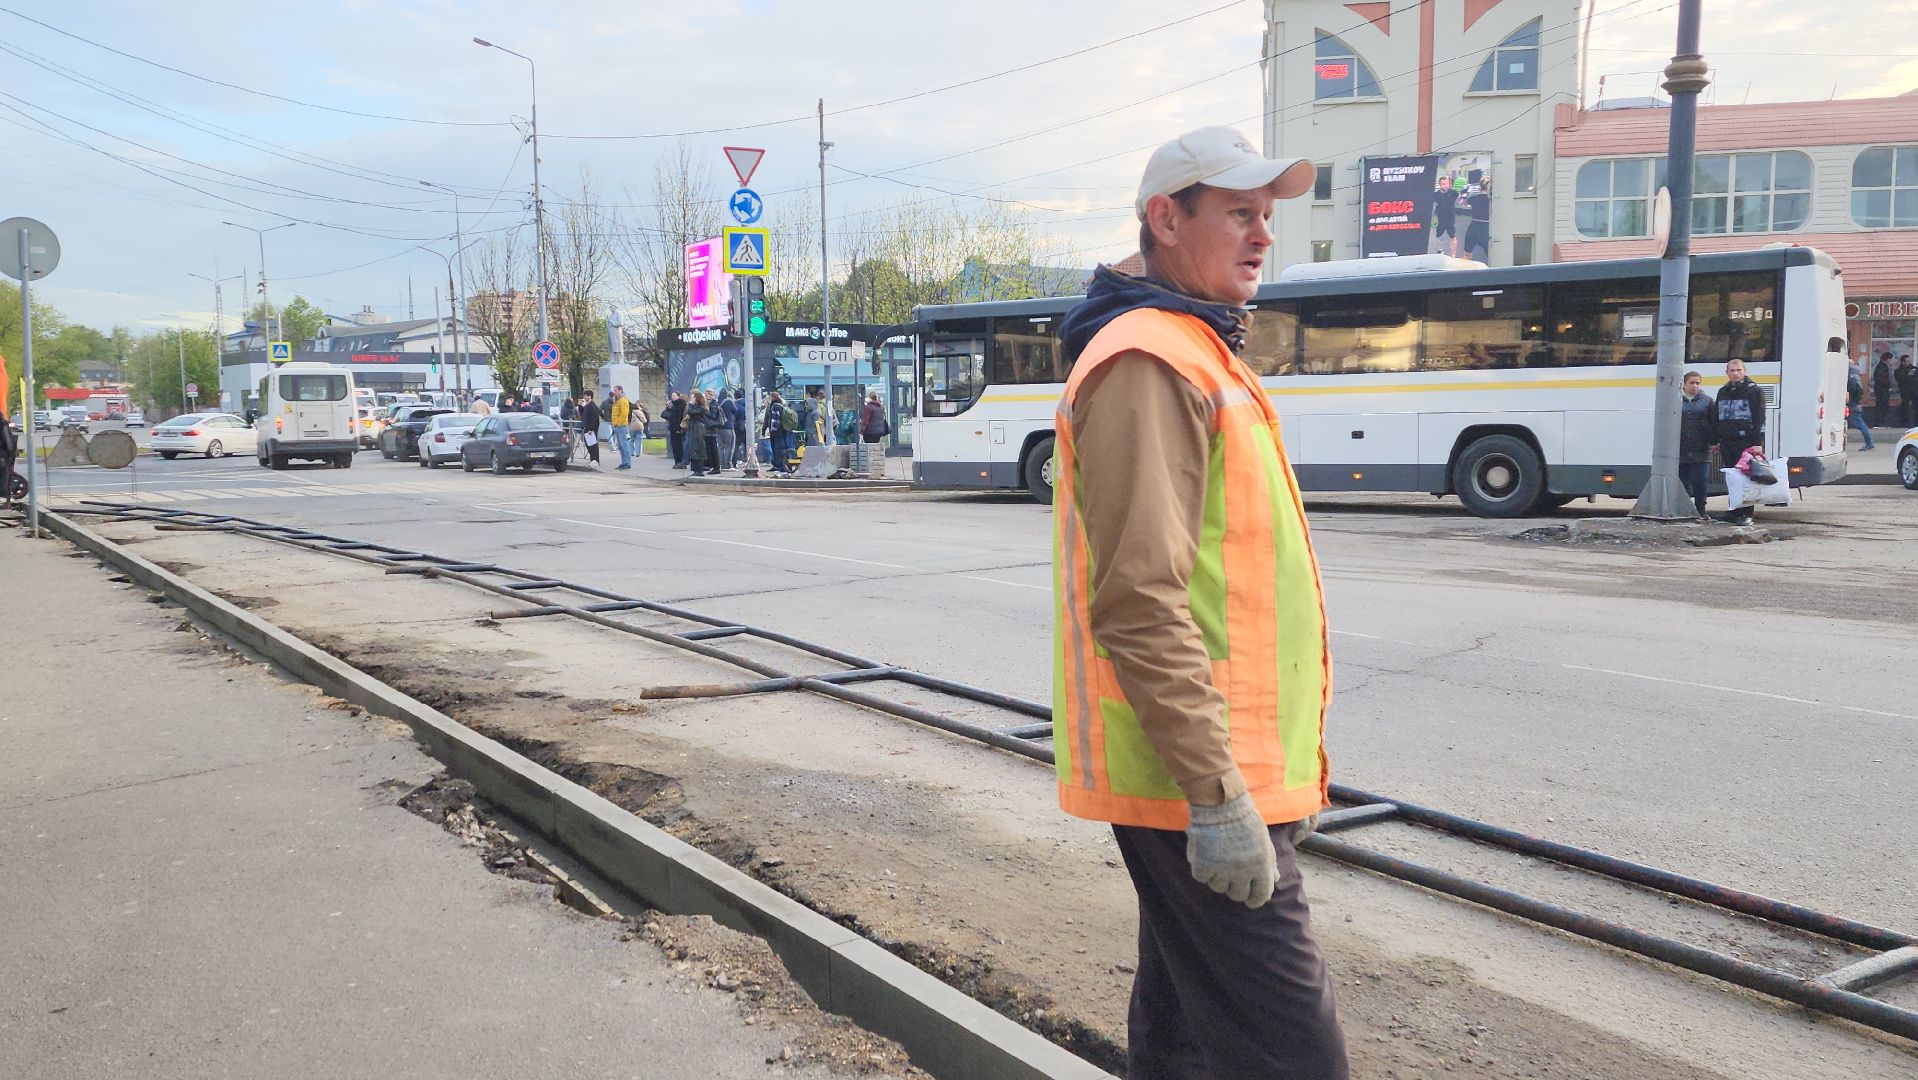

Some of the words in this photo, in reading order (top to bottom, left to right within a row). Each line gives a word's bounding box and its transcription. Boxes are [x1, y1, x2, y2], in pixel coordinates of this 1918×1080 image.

[1368, 201, 1414, 214] БОКС
[683, 326, 721, 344] кофейня
[808, 350, 847, 362] СТОП
